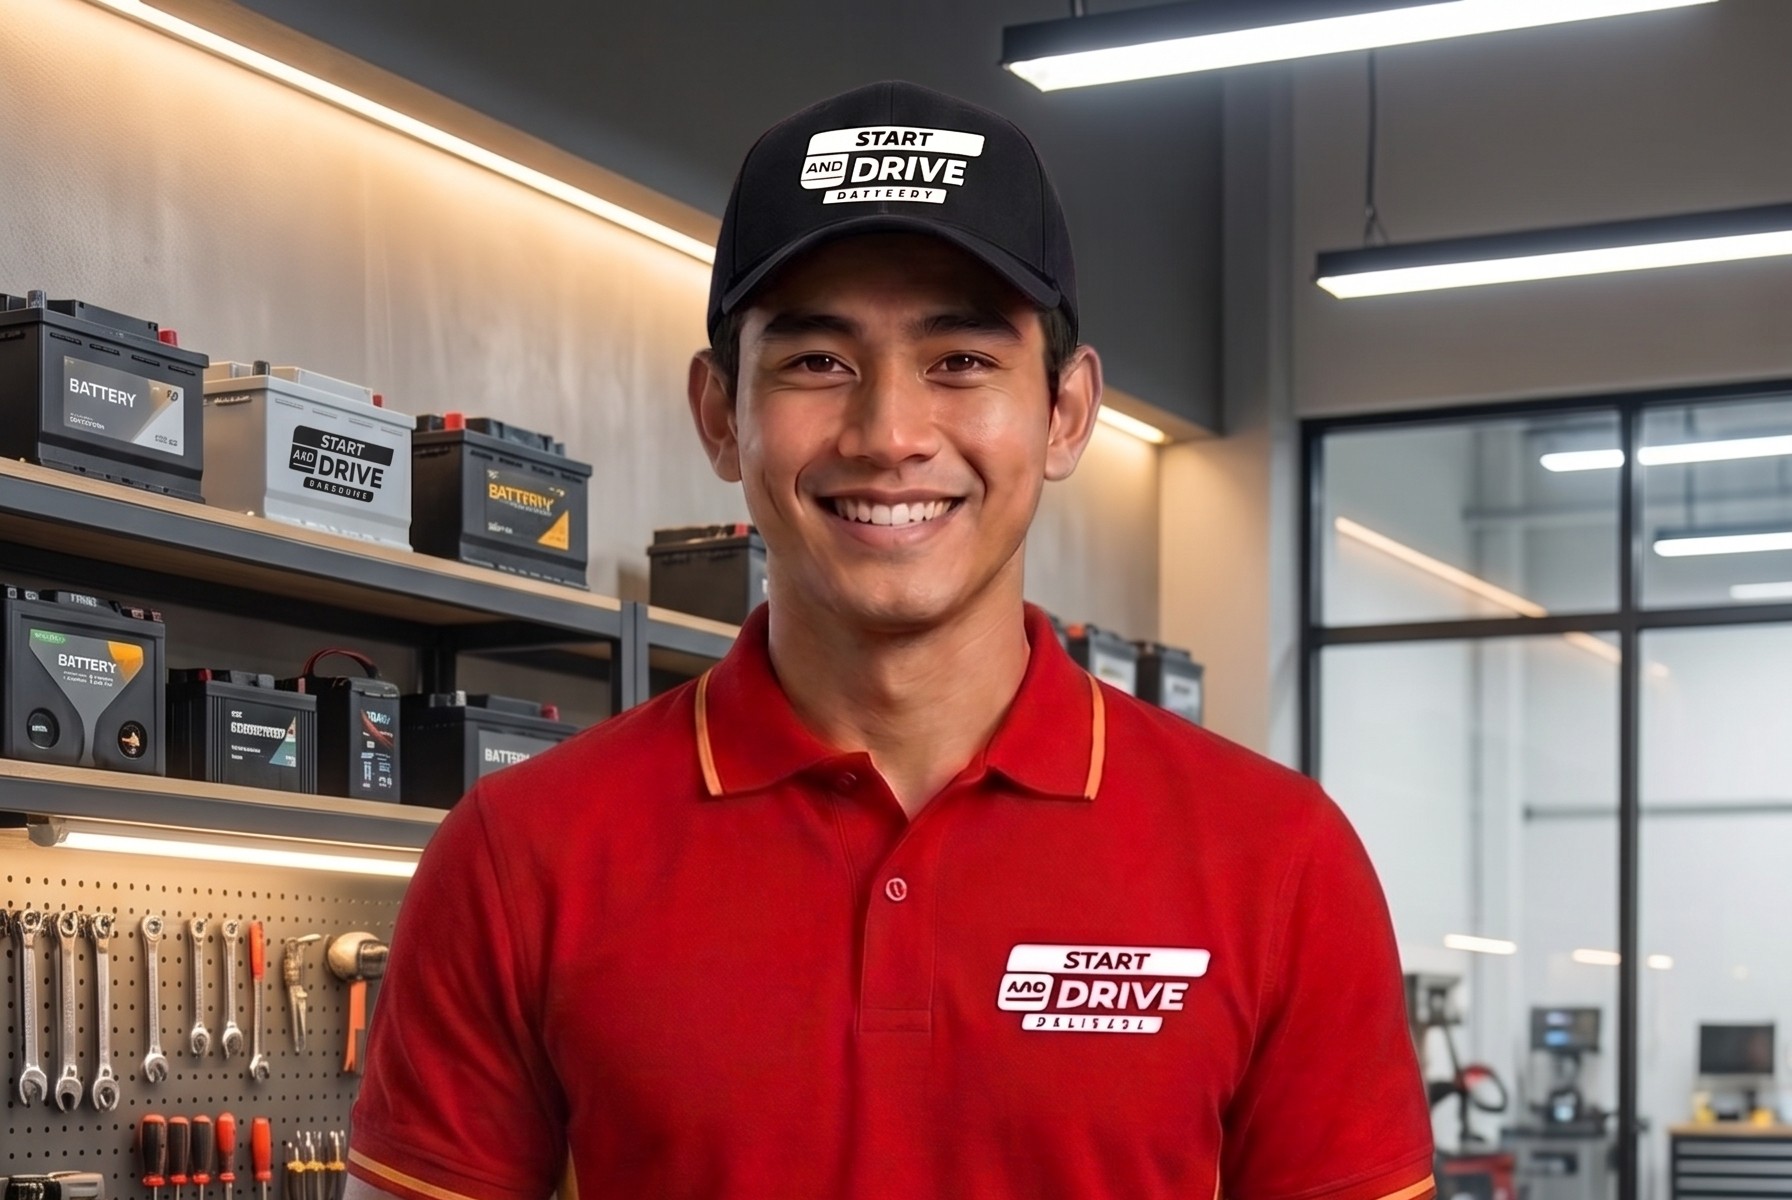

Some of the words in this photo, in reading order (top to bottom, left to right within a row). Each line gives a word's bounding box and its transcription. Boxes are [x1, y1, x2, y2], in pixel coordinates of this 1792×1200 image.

[855, 131, 934, 147] START
[806, 160, 843, 174] AND
[850, 155, 968, 187] DRIVE
[69, 377, 137, 408] BATTERY
[320, 434, 366, 456] START
[318, 454, 384, 489] DRIVE
[58, 653, 117, 674] BATTERY
[1063, 951, 1151, 970] START
[1056, 979, 1190, 1011] DRIVE
